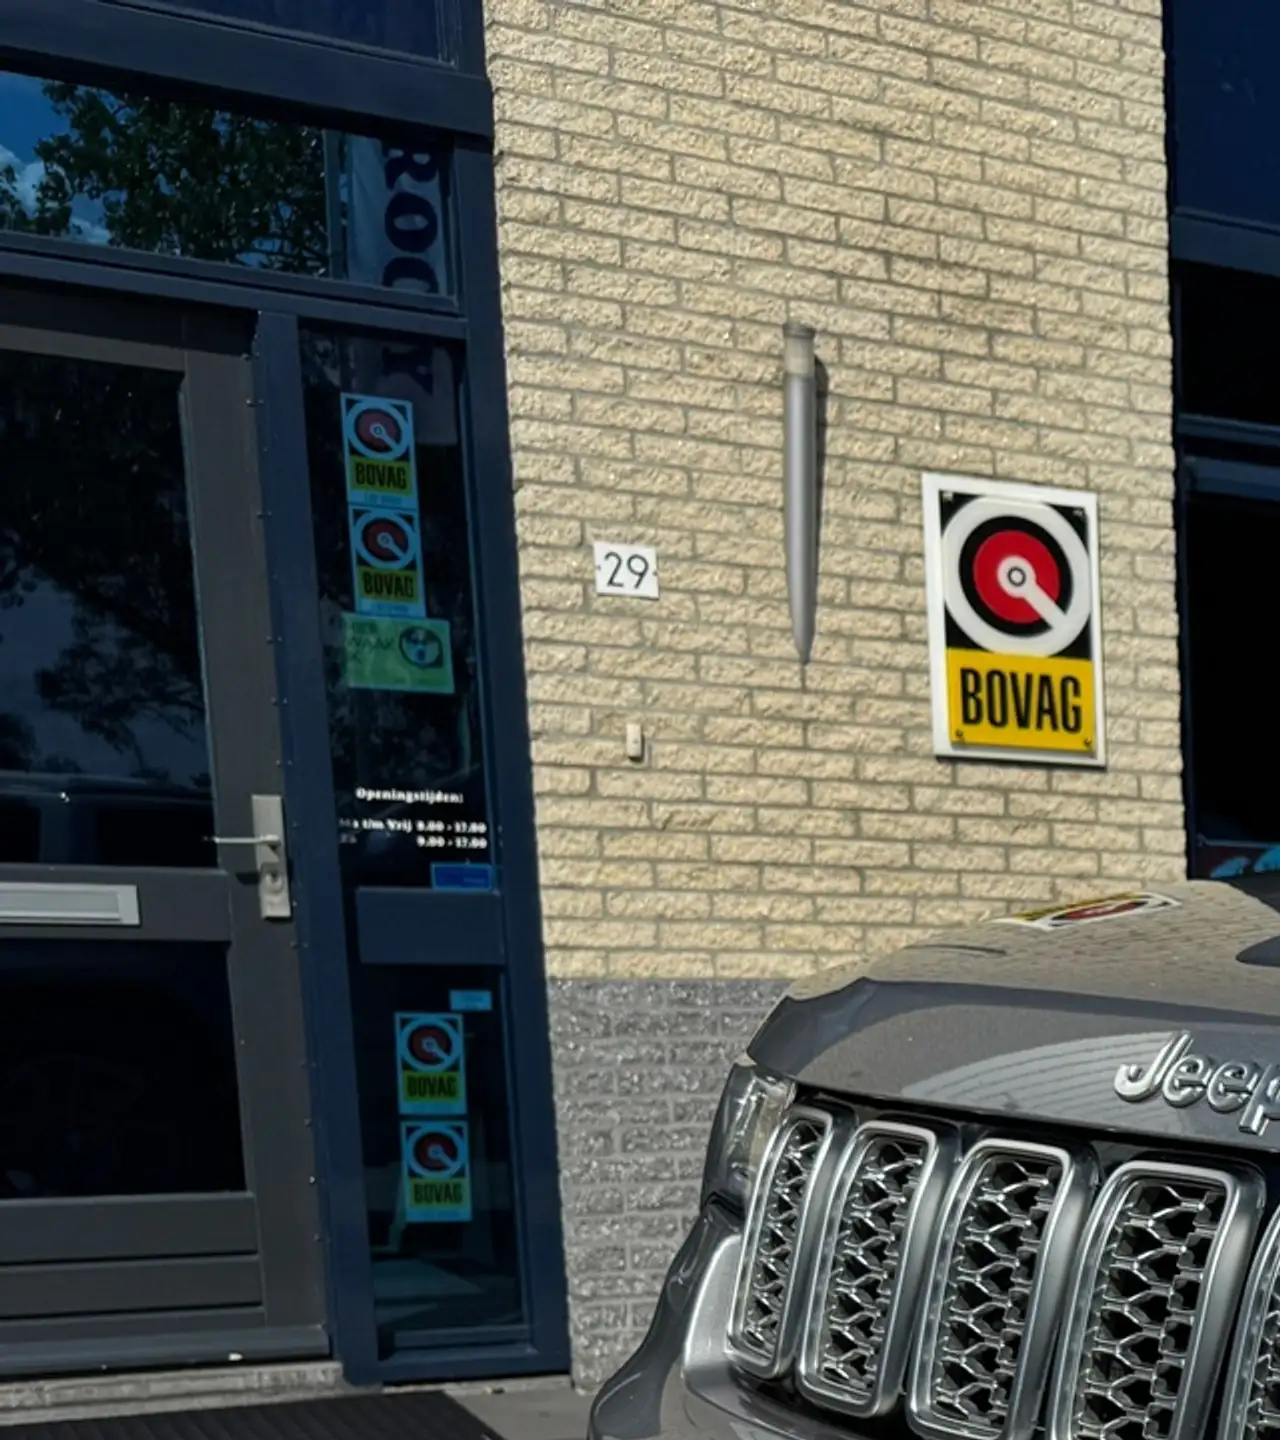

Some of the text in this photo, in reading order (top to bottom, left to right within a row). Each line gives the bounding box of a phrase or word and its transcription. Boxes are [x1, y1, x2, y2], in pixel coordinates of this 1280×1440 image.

[355, 461, 407, 490] BOVAG
[603, 551, 649, 590] 29
[362, 571, 414, 598] BOVAG
[960, 667, 1082, 734] BOVAG
[362, 818, 385, 830] t/m
[387, 818, 412, 833] Vrij
[407, 1075, 458, 1098] BOVAG
[414, 1183, 463, 1205] BOVAG
